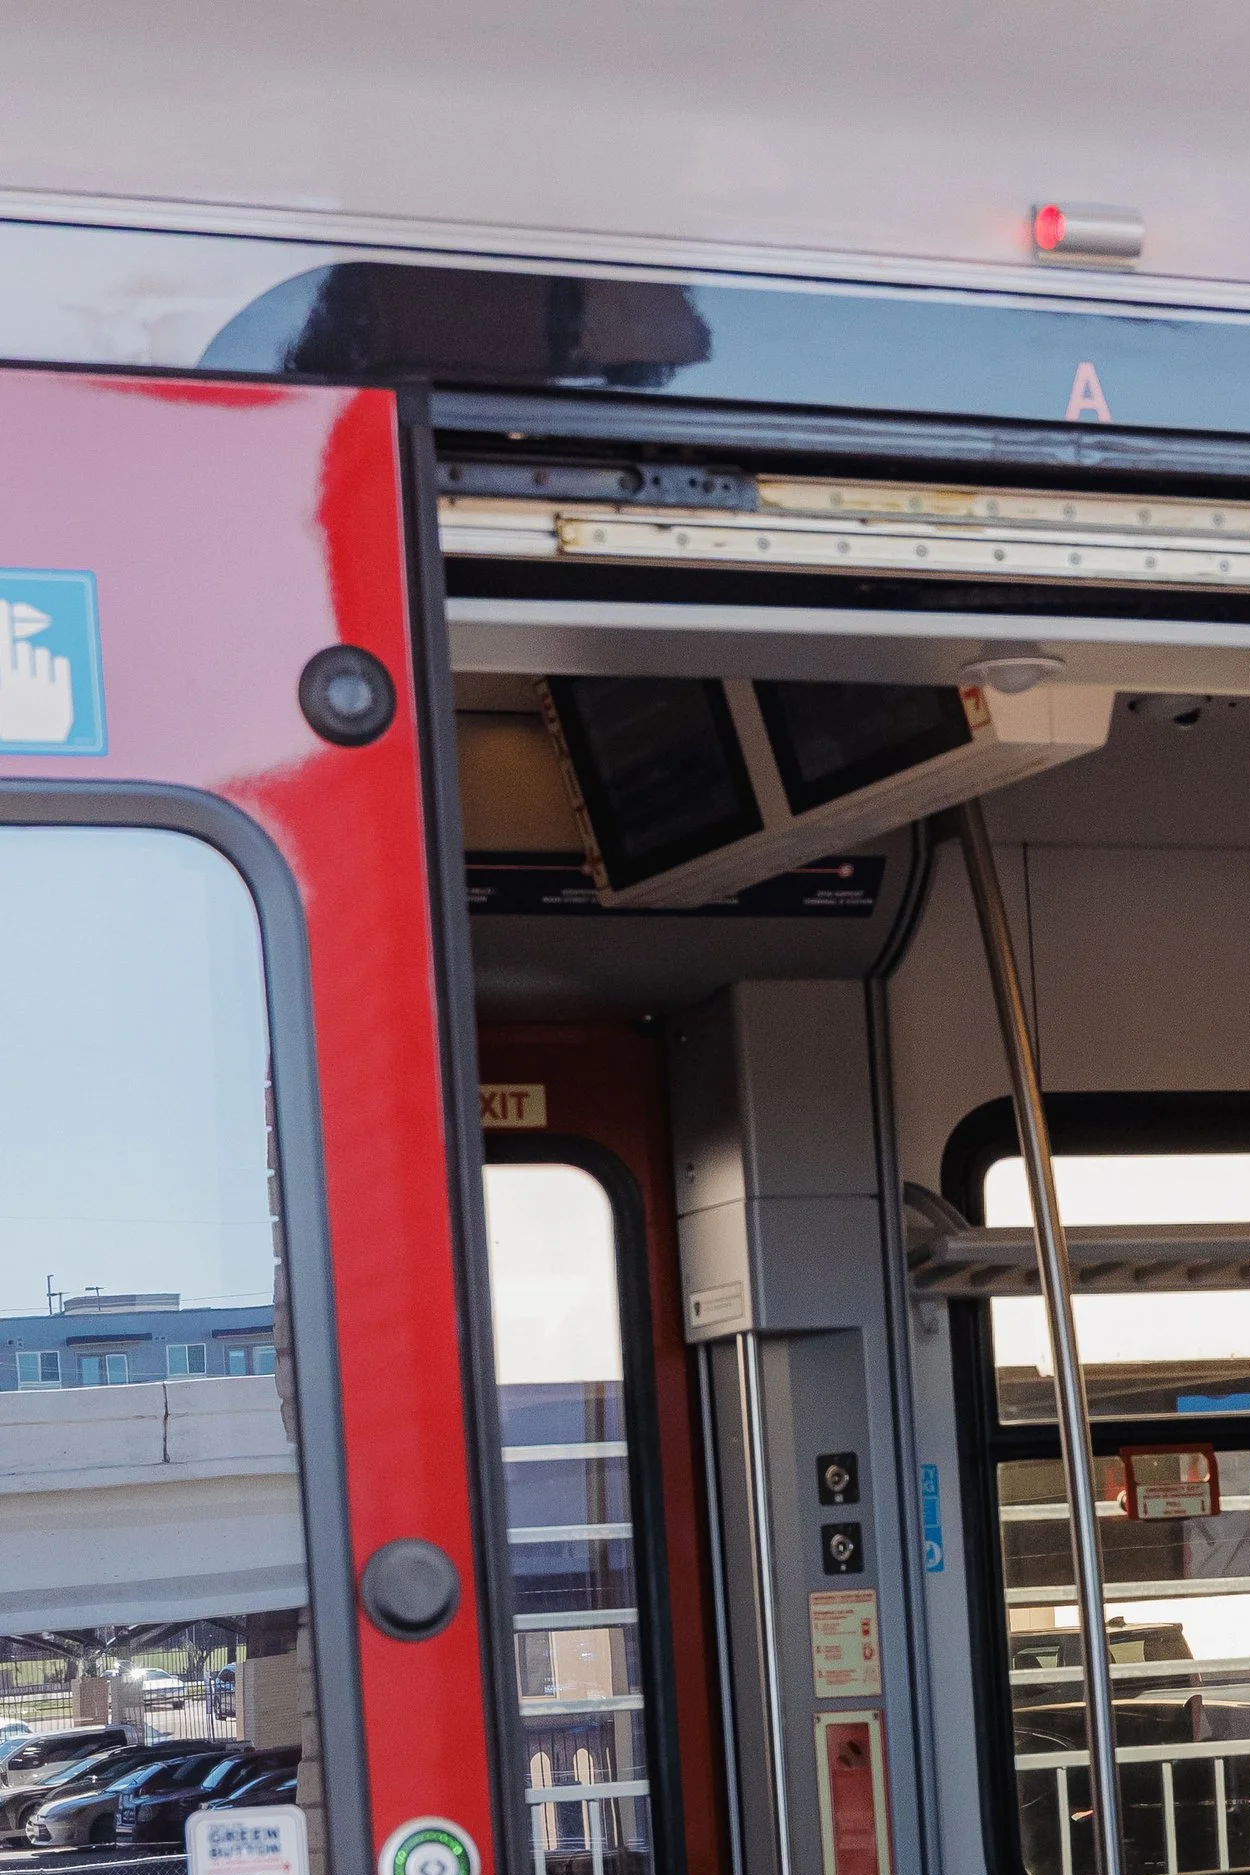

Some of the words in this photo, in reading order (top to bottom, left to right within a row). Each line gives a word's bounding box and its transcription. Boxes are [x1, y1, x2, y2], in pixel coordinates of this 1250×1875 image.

[1064, 361, 1111, 423] A
[480, 1091, 530, 1120] XIT
[208, 1827, 281, 1843] GREEN
[209, 1843, 282, 1860] BUTTON
